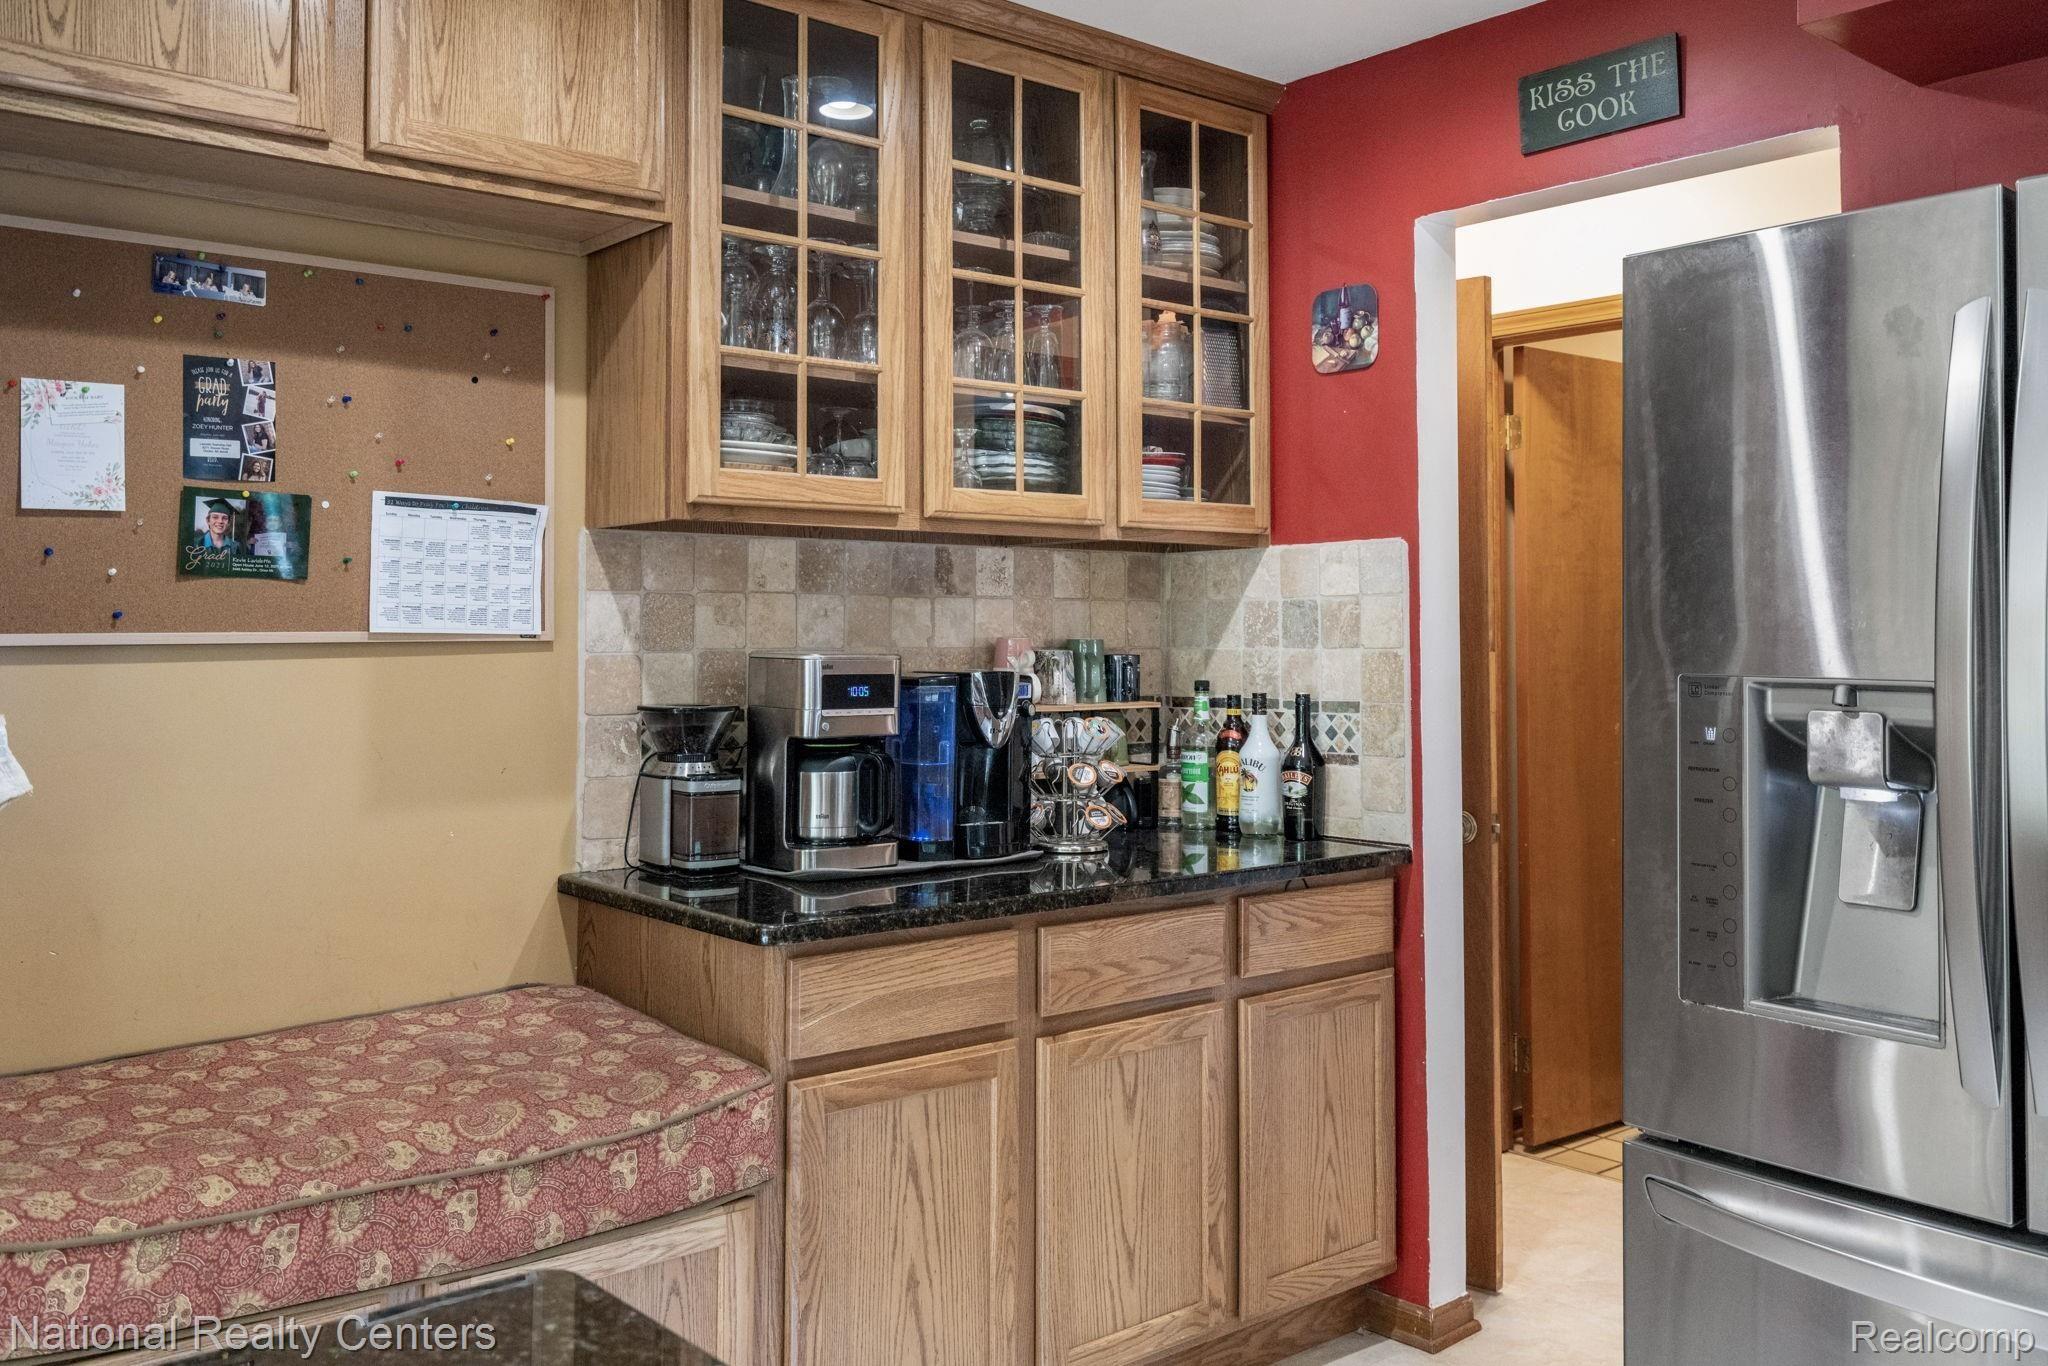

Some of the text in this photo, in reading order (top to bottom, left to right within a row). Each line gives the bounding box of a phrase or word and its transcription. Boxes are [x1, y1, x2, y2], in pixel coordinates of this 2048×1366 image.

[1529, 51, 1667, 111] KISS THE
[1557, 90, 1638, 132] COOK
[198, 376, 227, 395] GRAD
[195, 393, 229, 416] party
[185, 546, 229, 571] Grad
[1216, 762, 1240, 777] KAHLÚ
[1241, 758, 1266, 773] ALIBU
